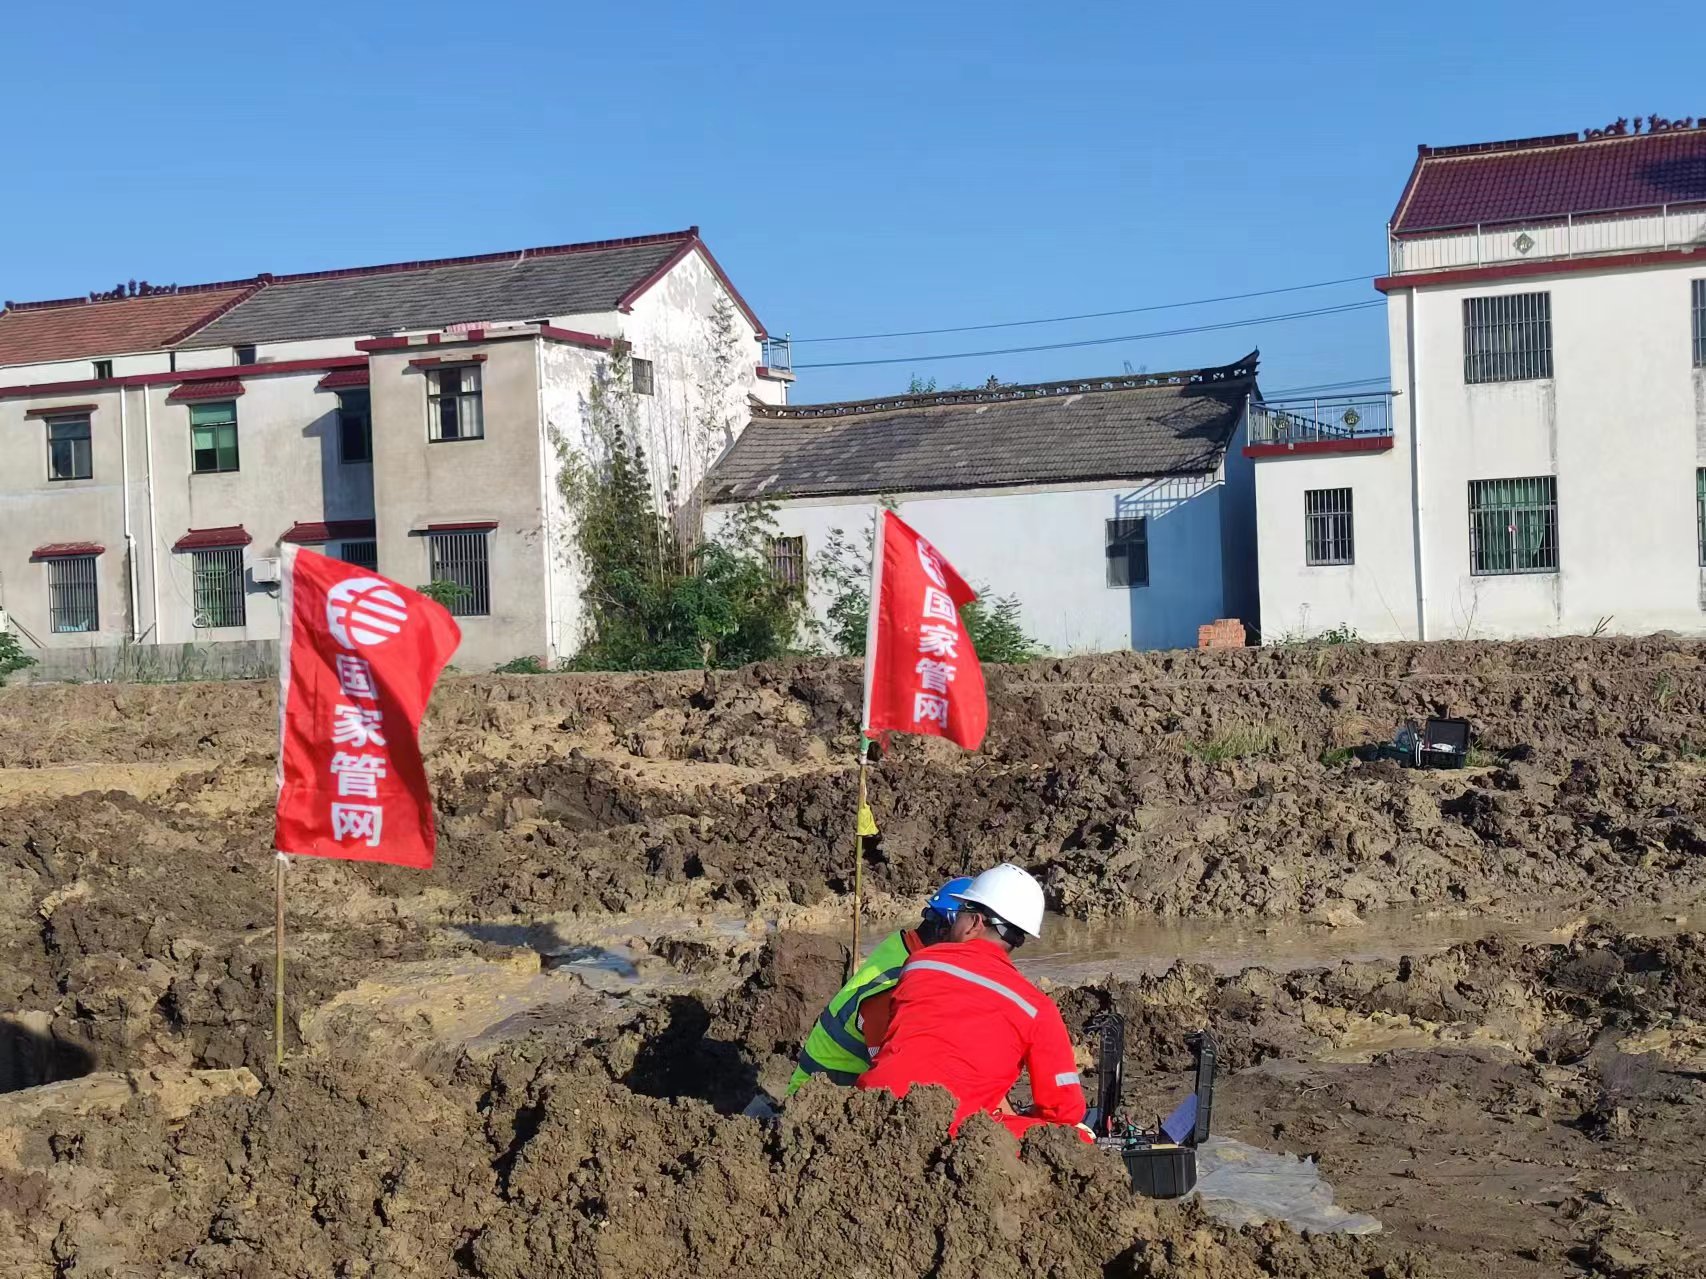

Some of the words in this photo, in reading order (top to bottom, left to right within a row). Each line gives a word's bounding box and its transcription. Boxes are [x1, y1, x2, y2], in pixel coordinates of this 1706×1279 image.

[914, 587, 959, 728] 国家管网
[331, 654, 386, 846] 国家管网
